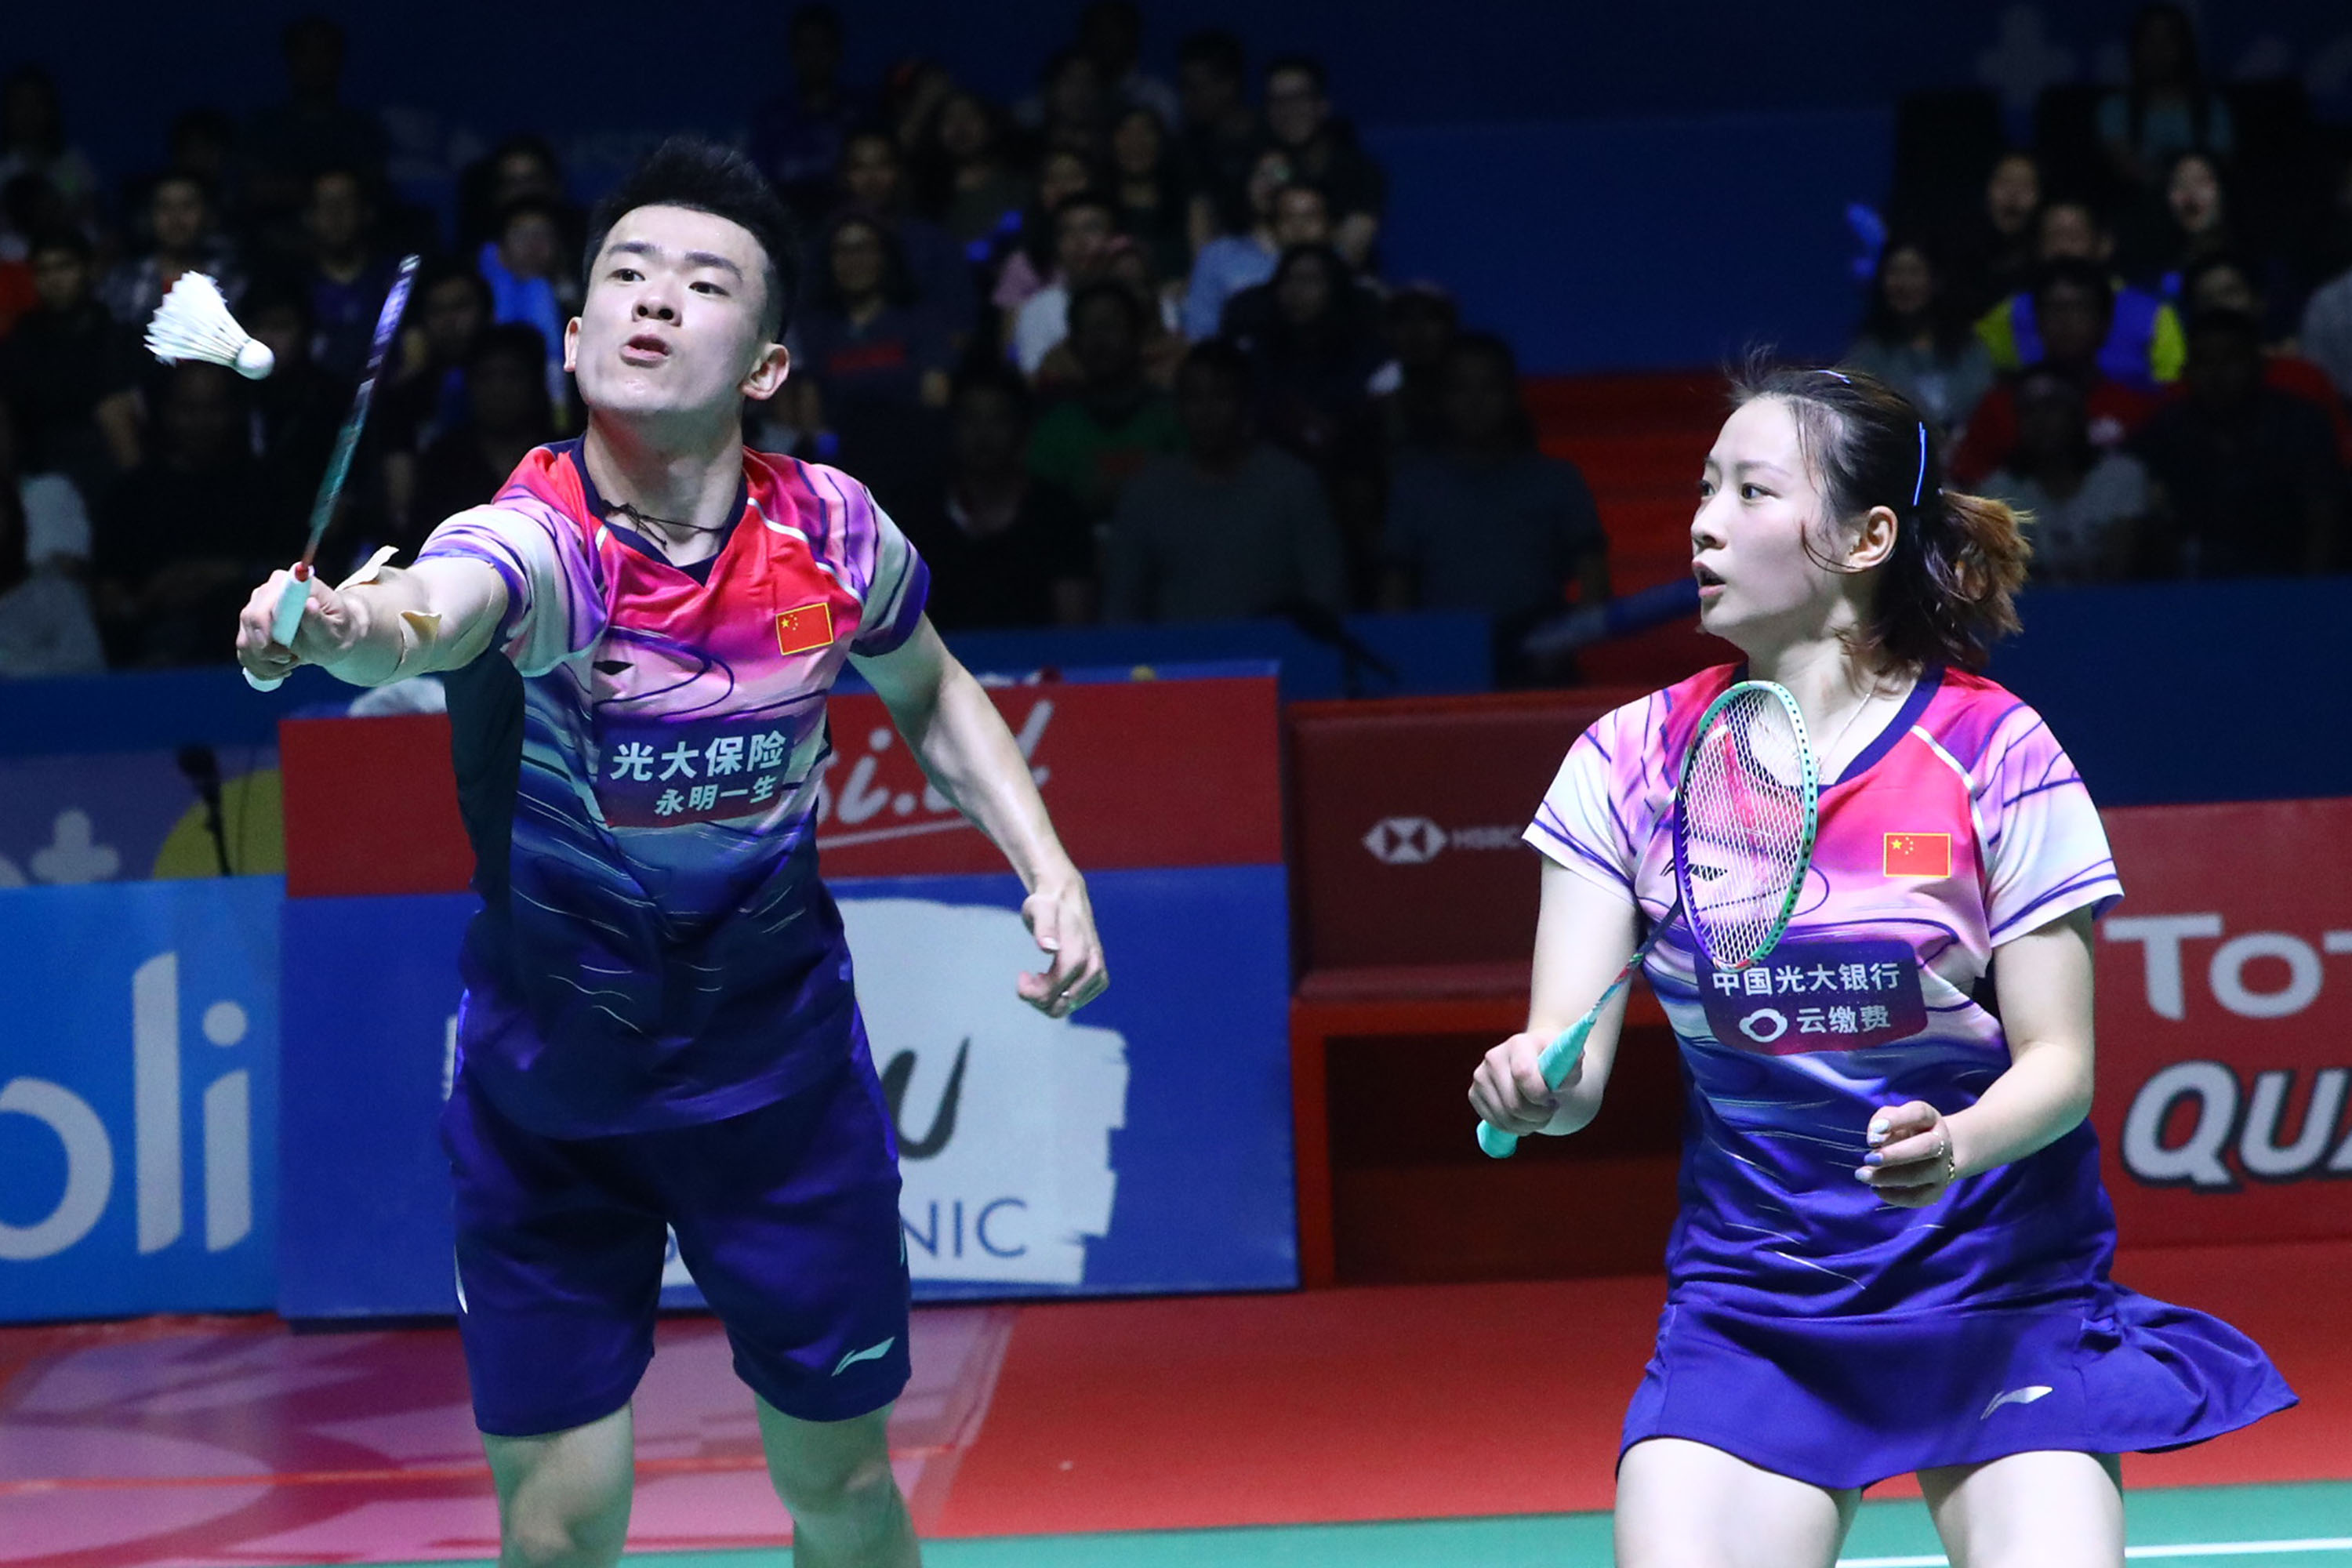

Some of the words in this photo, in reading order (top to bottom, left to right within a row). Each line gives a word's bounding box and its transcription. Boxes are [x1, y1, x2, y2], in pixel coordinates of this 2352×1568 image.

[610, 730, 786, 782] 光大保险
[654, 775, 777, 816] 永明一生
[1712, 963, 1900, 996] 中国光大银行
[2103, 912, 2352, 1021] TO
[1796, 1004, 1891, 1034] 云缴费
[2122, 1059, 2352, 1192] QU
